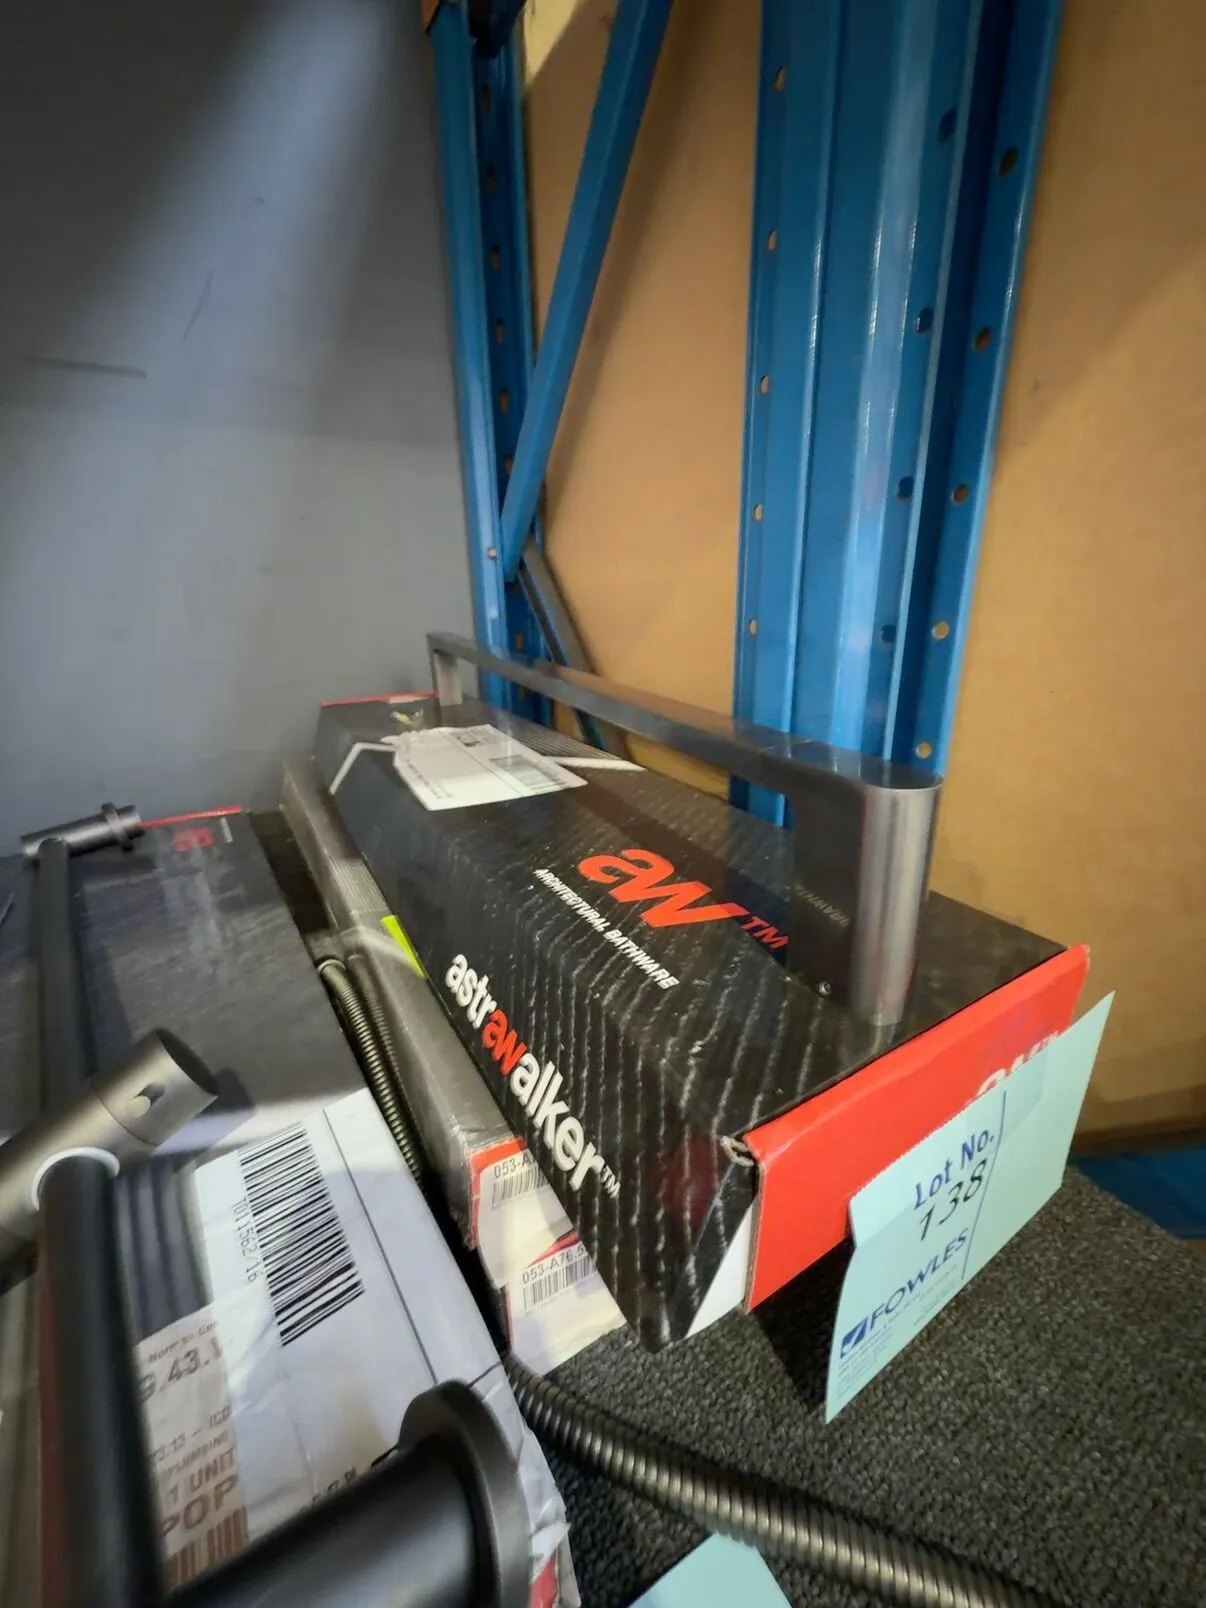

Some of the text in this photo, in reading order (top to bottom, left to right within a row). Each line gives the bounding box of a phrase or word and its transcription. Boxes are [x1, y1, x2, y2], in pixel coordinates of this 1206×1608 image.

[534, 868, 680, 990] ARCHITECTURAL BATHWARE
[445, 953, 604, 1191] astrawalker
[493, 1151, 536, 1179] 053-A
[912, 1130, 994, 1210] Lot No.
[920, 1159, 987, 1241] 138
[869, 1226, 971, 1332] FOWLES
[189, 1446, 235, 1493] UNIT
